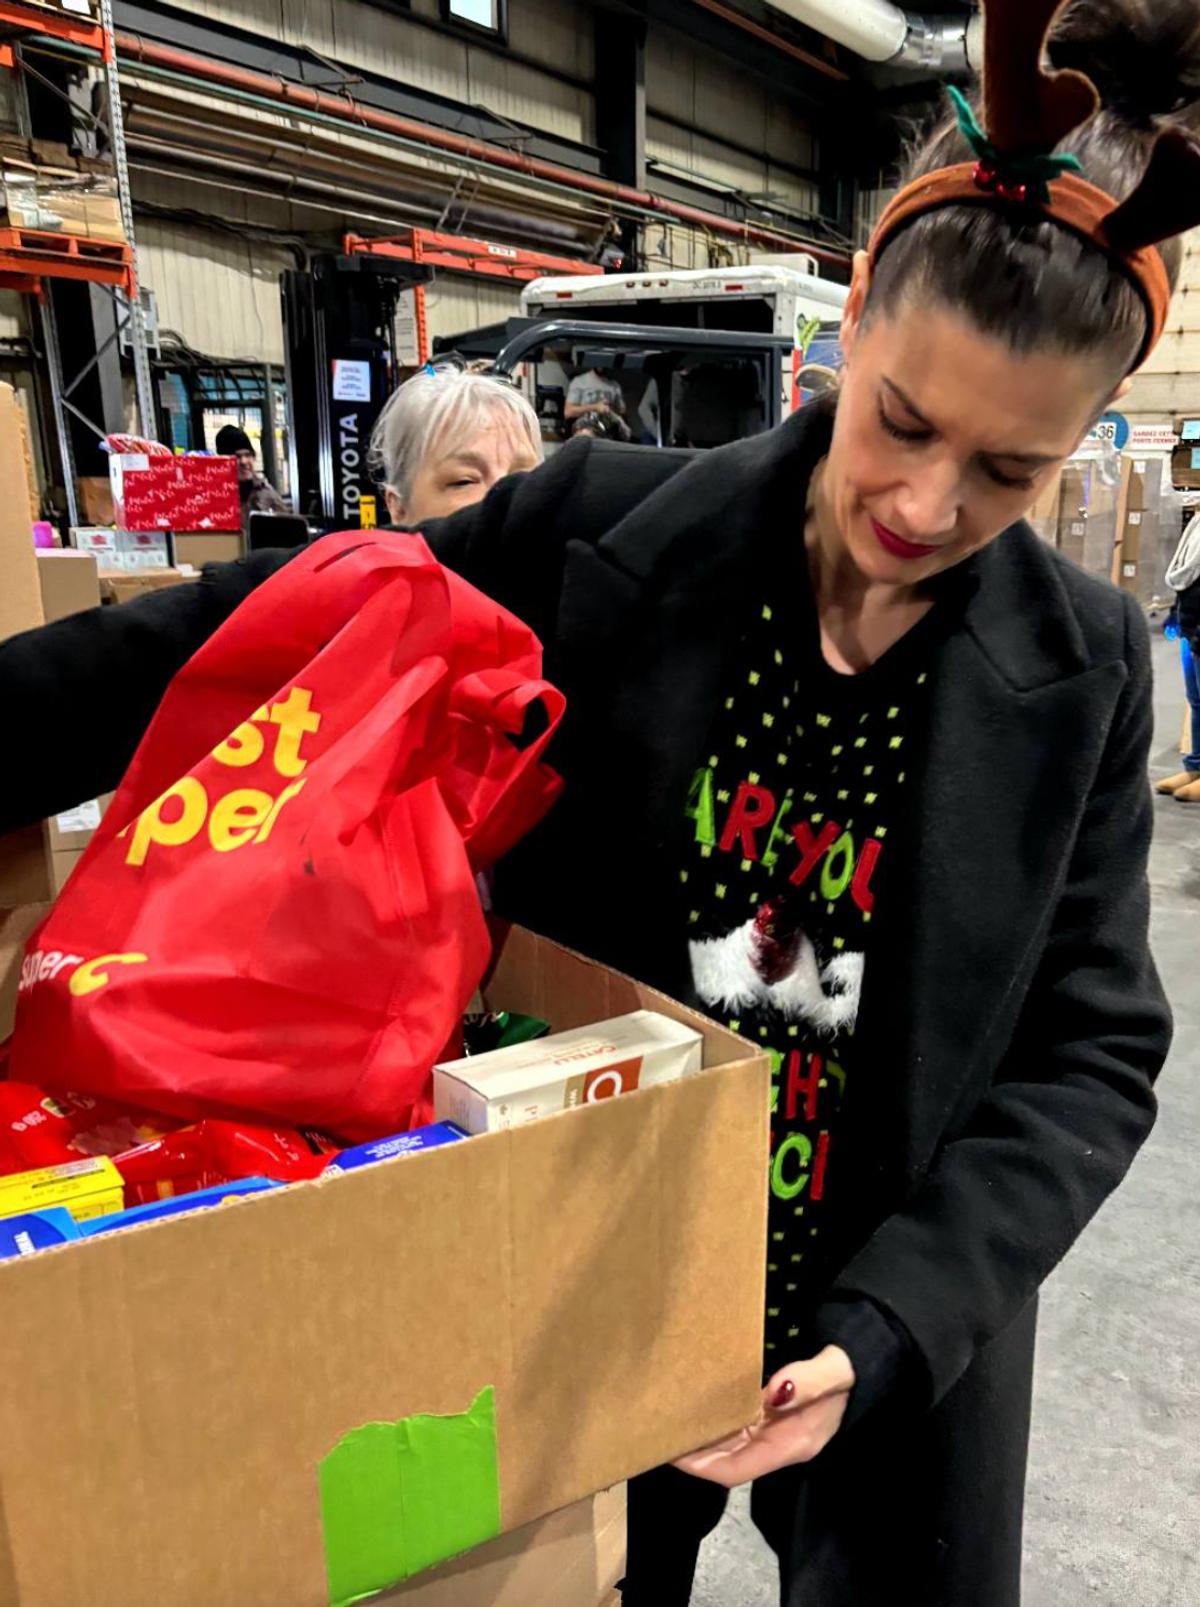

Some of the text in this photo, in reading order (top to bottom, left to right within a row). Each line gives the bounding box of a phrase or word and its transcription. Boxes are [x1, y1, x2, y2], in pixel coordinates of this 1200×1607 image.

[339, 413, 361, 520] TOYOTA
[1097, 425, 1114, 439] 36
[117, 776, 307, 866] per
